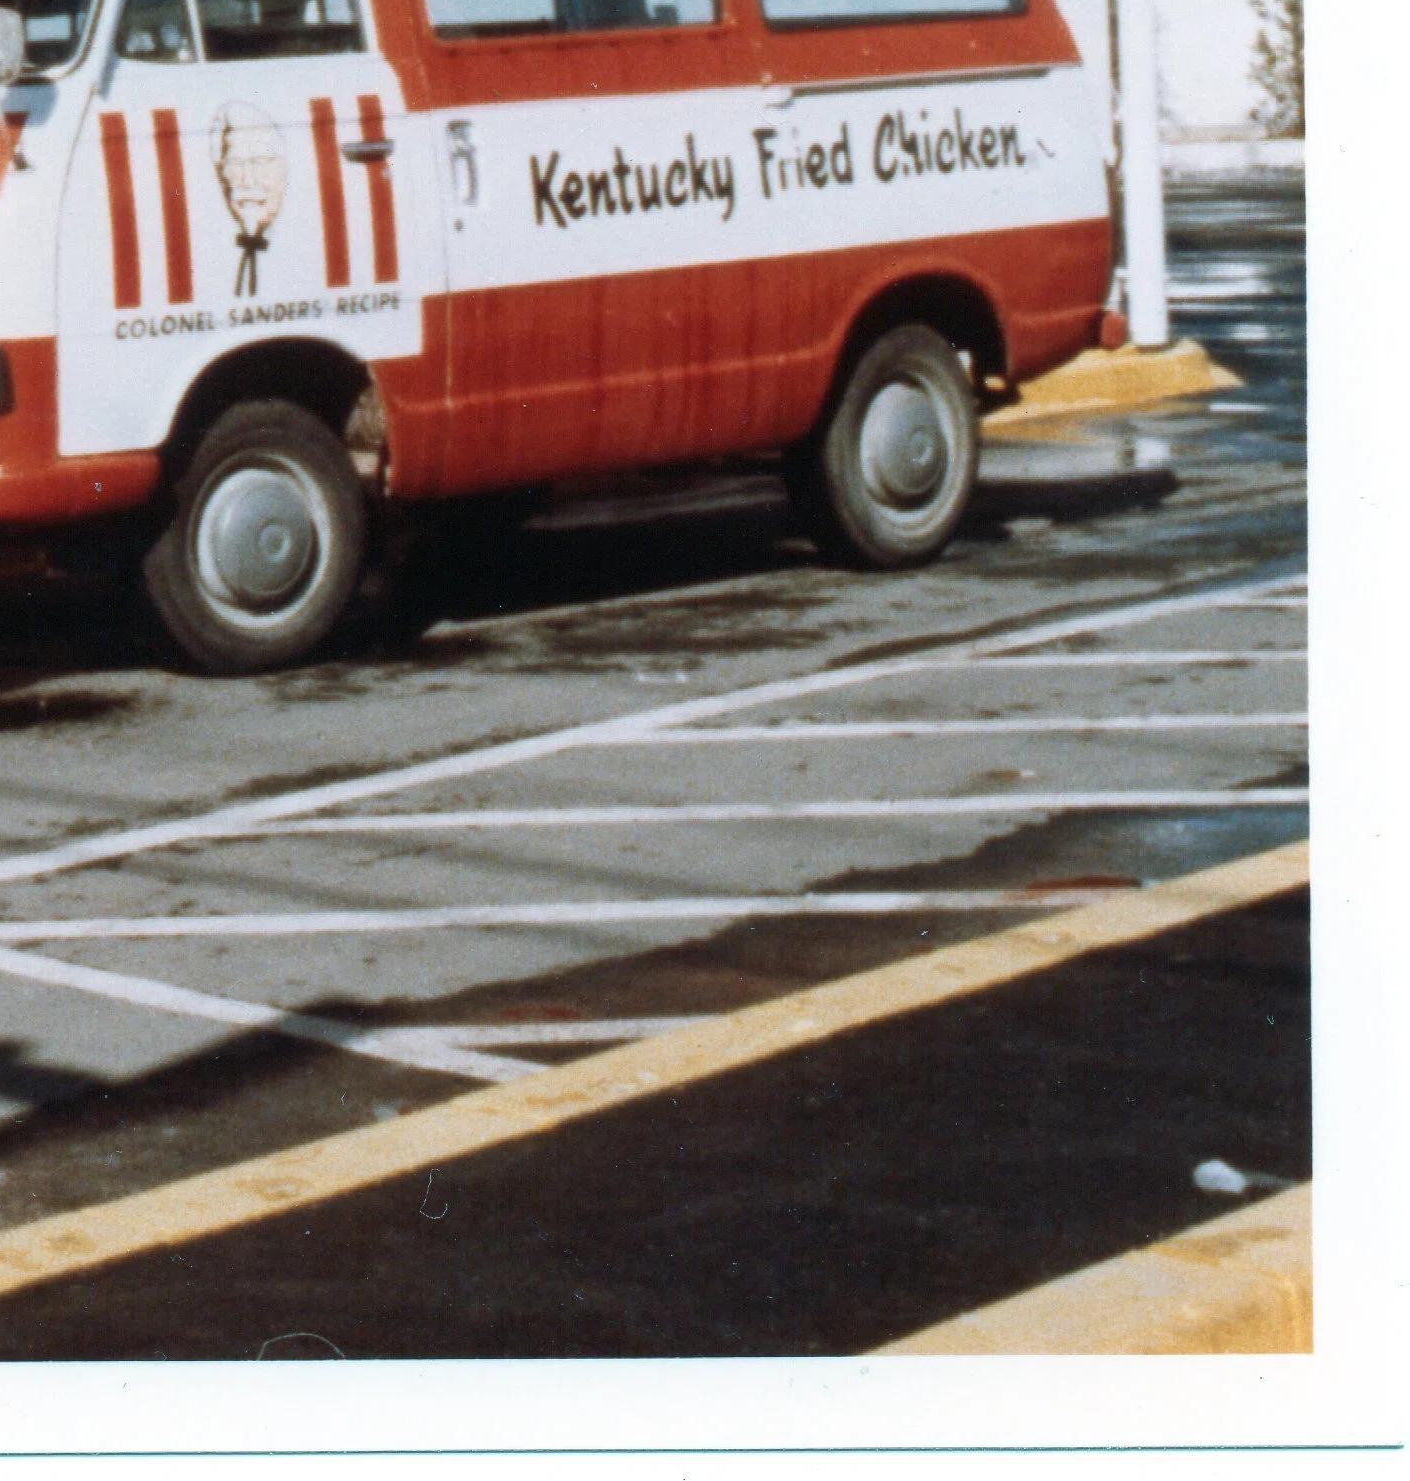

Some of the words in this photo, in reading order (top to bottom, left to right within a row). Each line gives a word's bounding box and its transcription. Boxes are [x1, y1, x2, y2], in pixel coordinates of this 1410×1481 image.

[530, 134, 735, 229] Kentucky
[752, 121, 854, 199] Fried
[873, 108, 1026, 183] Chicken
[114, 310, 215, 339] COLONEL
[335, 290, 400, 315] RECIPE
